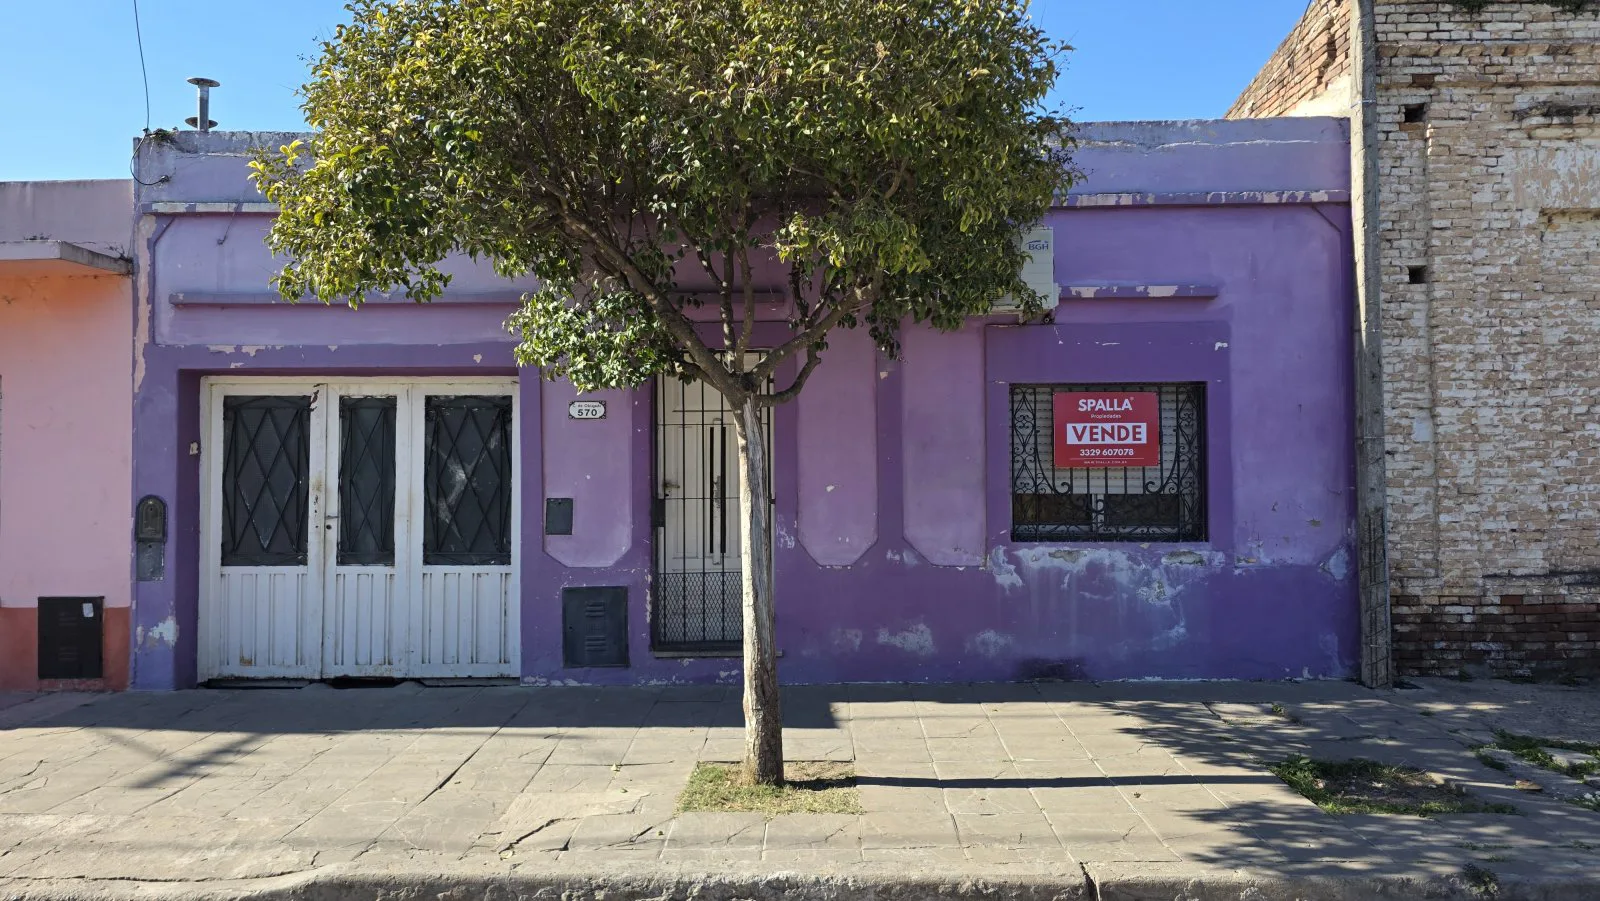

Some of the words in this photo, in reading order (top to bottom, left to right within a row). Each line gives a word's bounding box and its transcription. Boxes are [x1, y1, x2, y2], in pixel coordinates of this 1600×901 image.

[1078, 398, 1133, 411] SPALLA
[577, 408, 598, 417] 570
[1071, 425, 1142, 442] VENDE
[1079, 448, 1101, 456] 3329
[1102, 448, 1134, 456] 607078
